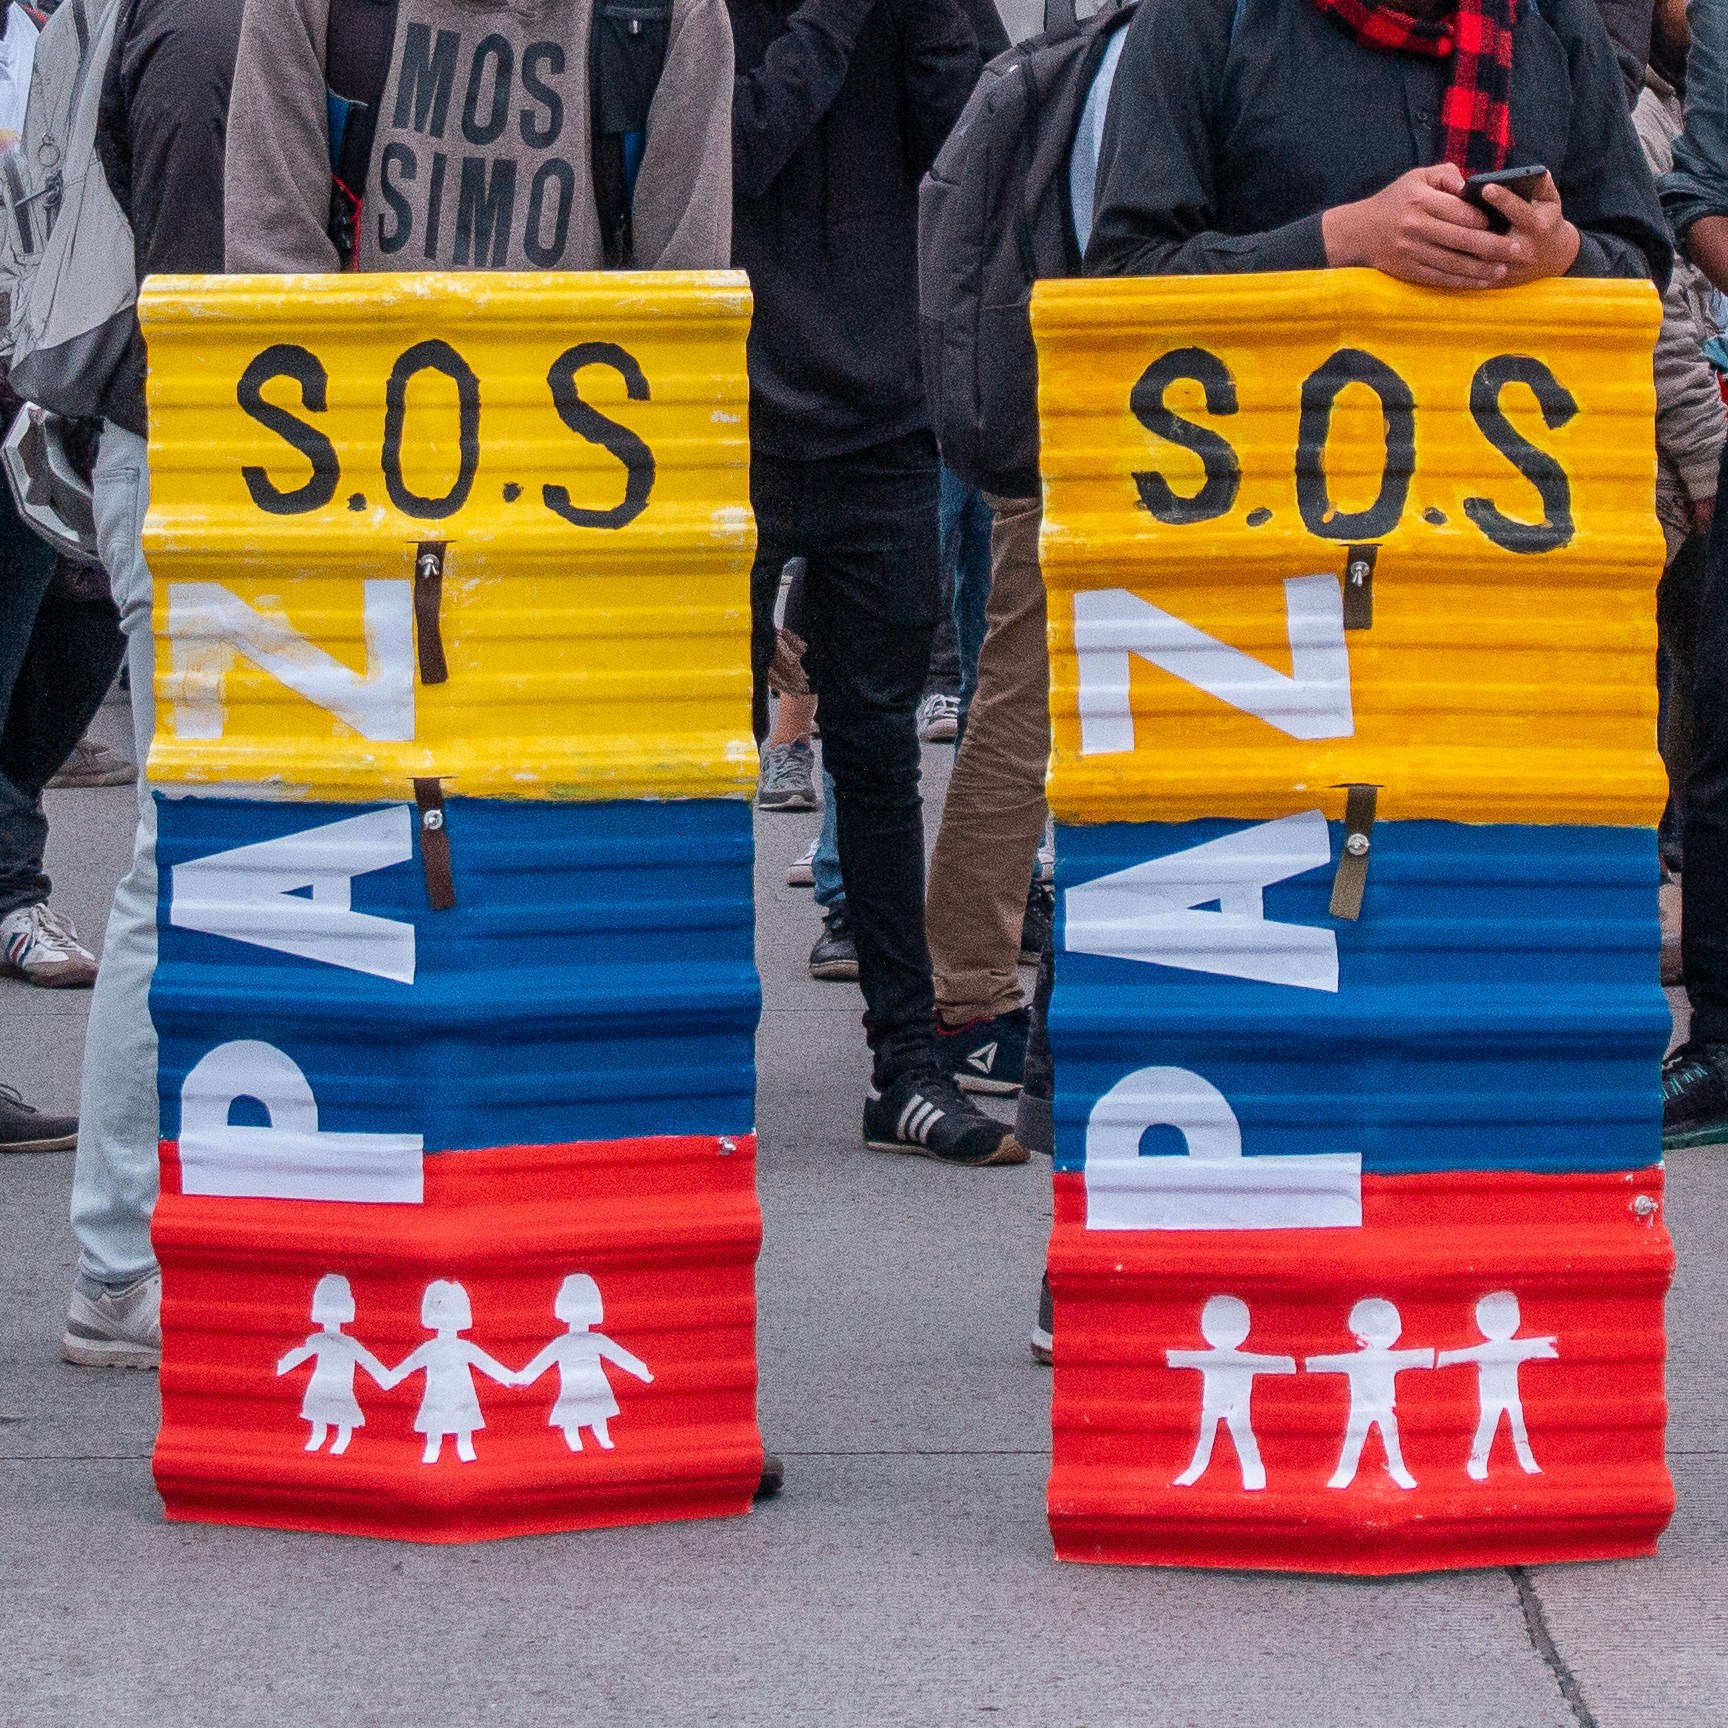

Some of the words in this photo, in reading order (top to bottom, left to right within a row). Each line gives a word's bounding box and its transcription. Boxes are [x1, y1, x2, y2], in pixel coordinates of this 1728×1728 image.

[393, 22, 566, 149] MOS
[377, 142, 576, 268] SIMO
[236, 339, 656, 530] S.O.S
[1129, 346, 1580, 554] S.O.S
[167, 579, 424, 1204] PAZ
[1064, 573, 1362, 1231] PAZ
